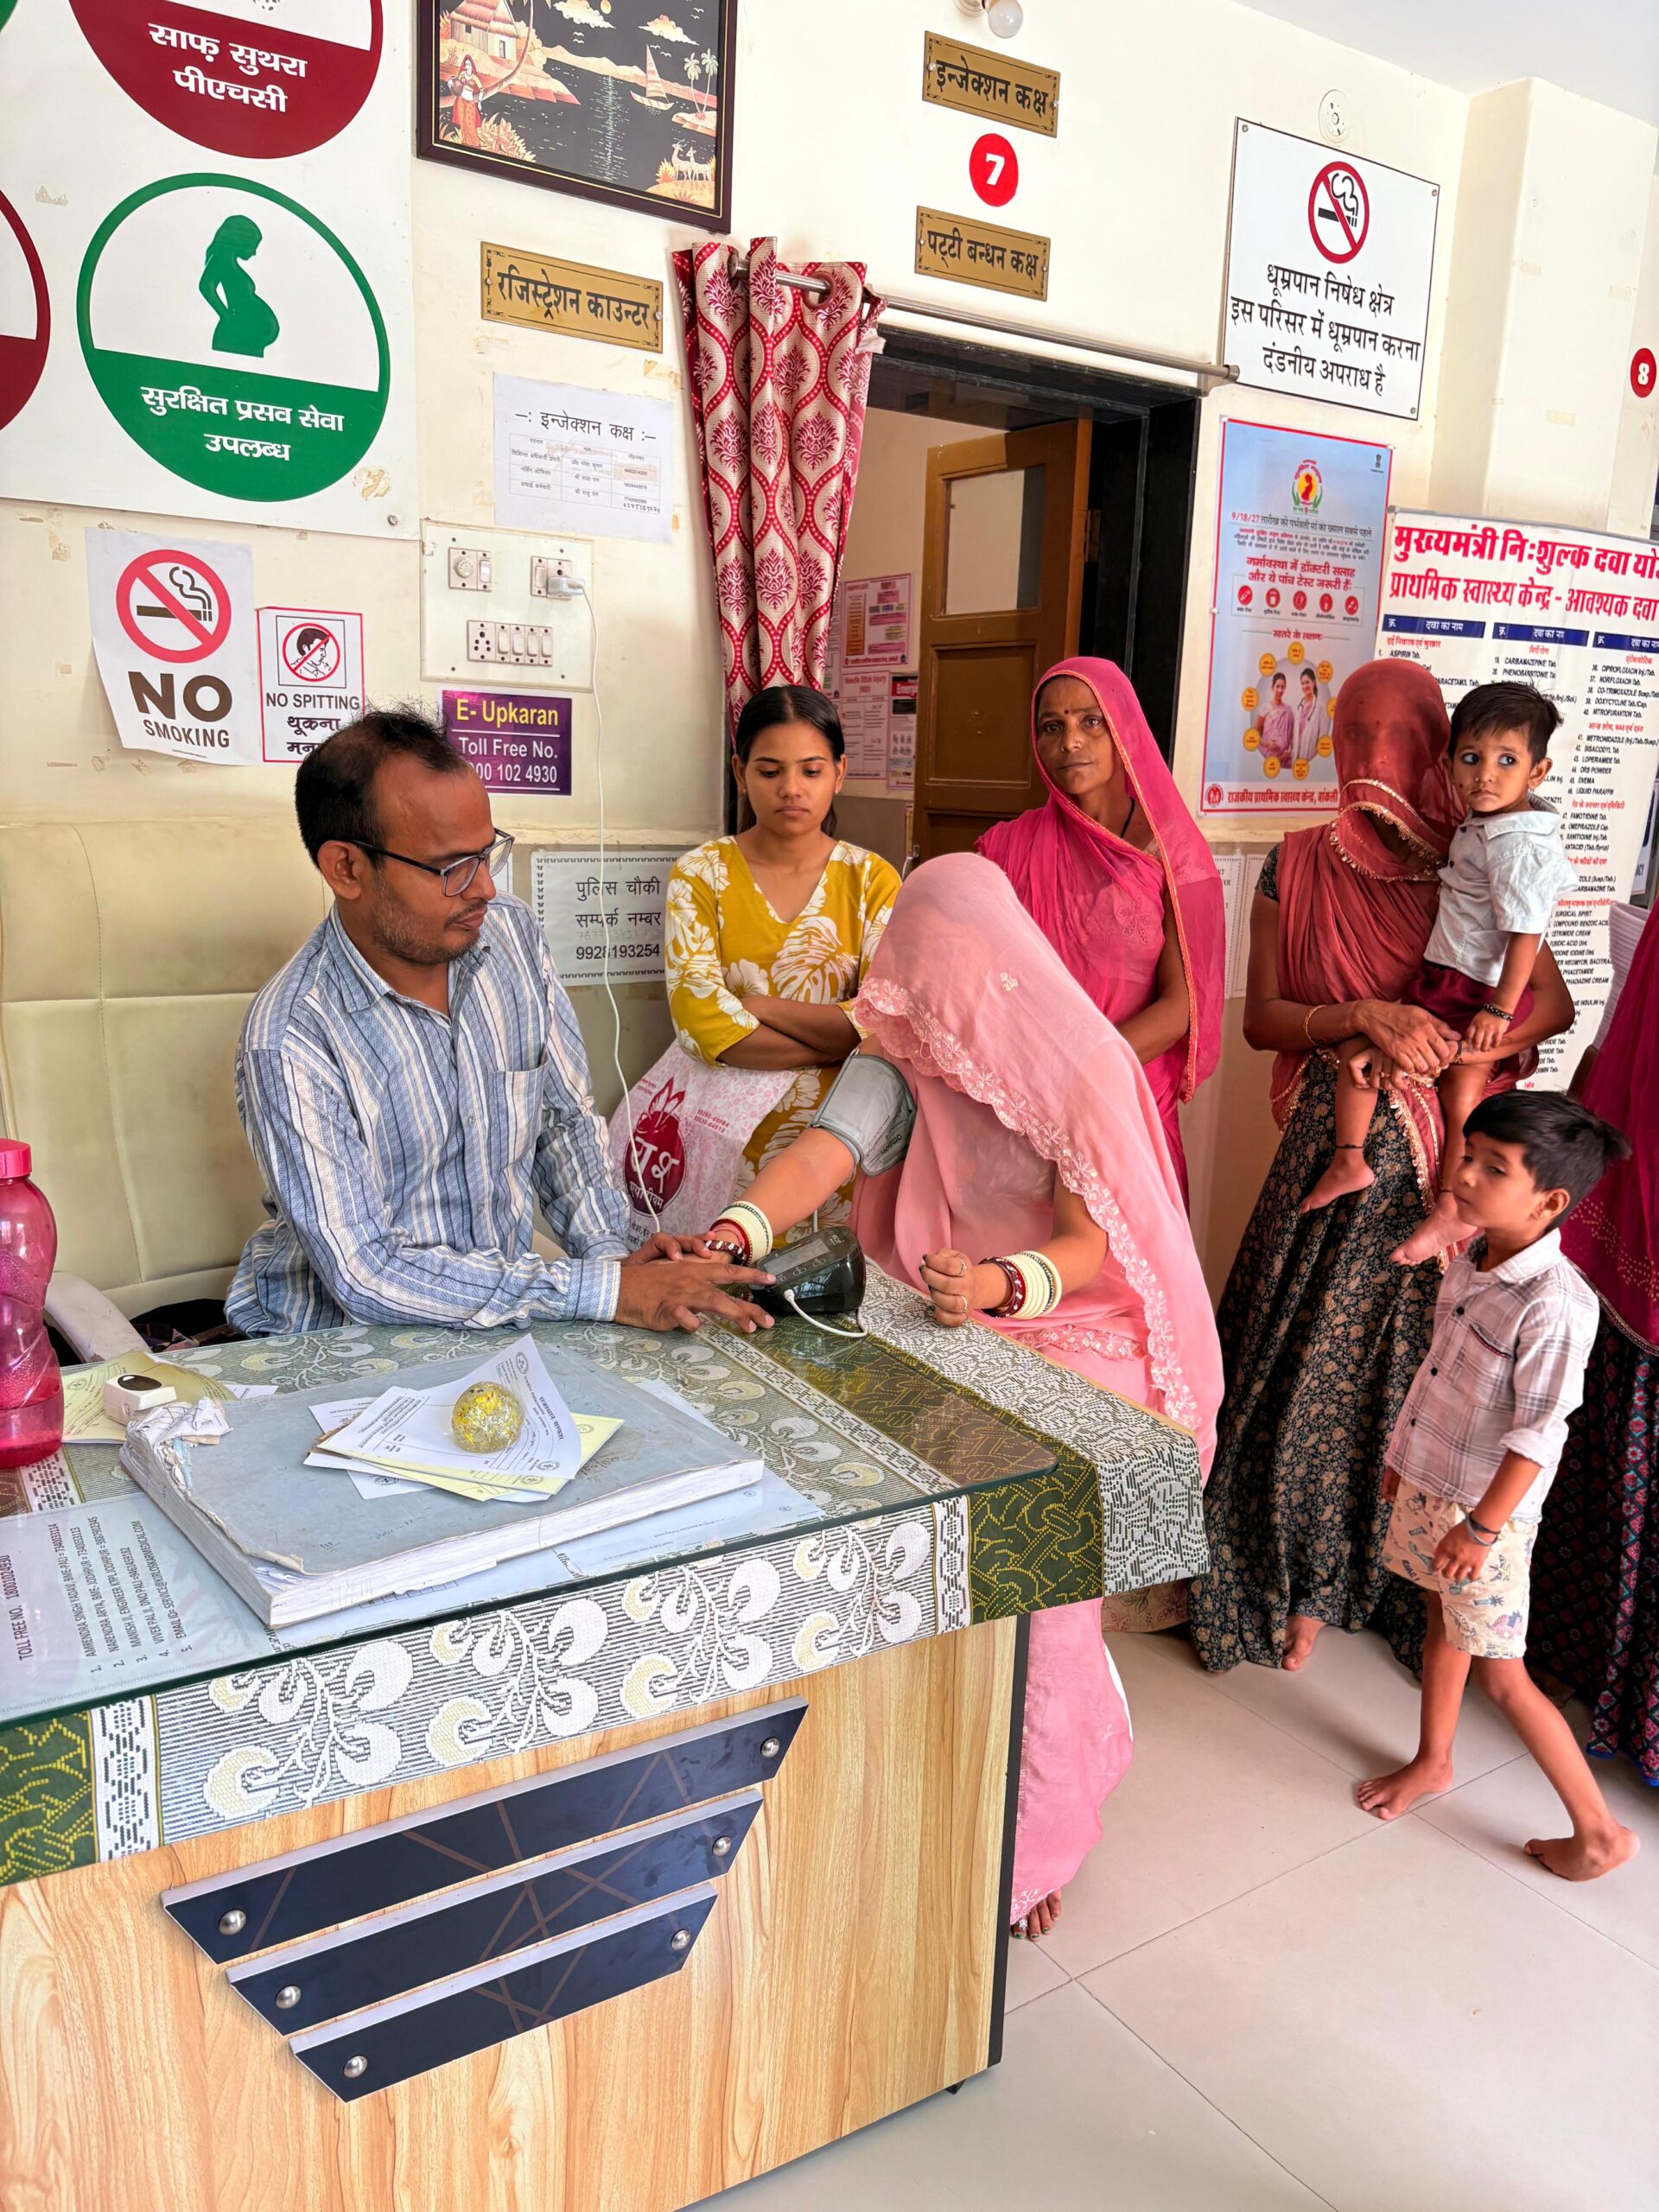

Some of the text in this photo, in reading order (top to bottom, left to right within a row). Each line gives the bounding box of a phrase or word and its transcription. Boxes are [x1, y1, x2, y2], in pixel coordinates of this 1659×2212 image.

[148, 22, 308, 78] साफ़ सुथरा
[172, 69, 289, 114] पीएचसी
[935, 54, 1049, 115] इन्जेक्शन कक्ष
[985, 152, 1005, 187] 7
[967, 238, 1007, 270] बन्धन
[1010, 249, 1039, 280] कक्ष
[497, 264, 650, 329] रजिस्ट्रेशन काउन्टर
[1267, 263, 1395, 317] धूम्रपान निषेध क्षेत्र
[1230, 296, 1421, 363] इस परिसर में धूम्रपान करना
[1262, 341, 1386, 396] दंडनीय अपराध है
[1638, 362, 1649, 385] 8
[139, 385, 345, 432] सुरक्षित प्रसव सेवा
[540, 410, 602, 436] इन्जेक्शन
[608, 423, 635, 442] कक्ष
[204, 433, 292, 462] उपलब्ध
[1281, 516, 1288, 526] को
[1394, 524, 1499, 563] मुख्यमंत्री
[1595, 547, 1631, 575] दवा
[1249, 569, 1266, 582] और
[1268, 571, 1275, 582] ये
[1279, 573, 1294, 585] पांच
[1297, 574, 1313, 587] टेस्ट
[1300, 561, 1330, 574] डॉक्टरी
[1332, 566, 1356, 577] सलाह
[1389, 568, 1460, 601] प्राथमिक
[1462, 579, 1516, 606] स्वास्थ्य
[1519, 576, 1554, 611] केन्द्र
[1566, 588, 1631, 617] आवश्यक
[1273, 628, 1291, 639] खतरे
[1294, 629, 1300, 639] के
[1426, 620, 1440, 631] दवा
[1440, 622, 1450, 631] का
[128, 671, 232, 722] NO
[266, 692, 359, 709] NO SPITTING
[287, 716, 340, 736] थूकना
[457, 699, 558, 728] E- Upkaran
[143, 719, 230, 748] SMOKING
[459, 737, 557, 759] Toll Free No.
[497, 764, 521, 782] 102
[525, 765, 557, 783] 4930
[575, 876, 661, 901] पुलिस चौकी
[575, 908, 661, 927] सम्पर्क नम्बर
[576, 944, 660, 959] 9928193254
[57, 1556, 73, 1581] BME-PALI
[80, 1560, 97, 1586] JODHPUR
[99, 1548, 115, 1573] JODHPUR
[130, 1520, 175, 1609] SERVICE@KIRLOSKARMEDICAL.COM
[65, 1580, 80, 1602] YADAV,
[132, 1580, 145, 1592] PALI
[71, 1602, 86, 1621] SINGH
[93, 1599, 108, 1618] ARYA,
[111, 1586, 130, 1614] ENGINEER
[137, 1592, 150, 1606] DNO
[9, 1605, 24, 1621] NO.
[143, 1612, 157, 1624] PAL
[166, 1608, 179, 1618] ID=
[11, 1620, 29, 1640] FREE
[76, 1621, 97, 1657] AMRENDRA
[99, 1618, 119, 1652] NARENDRA
[124, 1620, 142, 1647] MANISH
[149, 1624, 164, 1643] VIVEK
[170, 1618, 187, 1638] EMAIL
[16, 1639, 34, 1661] TOLL
[90, 1664, 101, 1673] 1.
